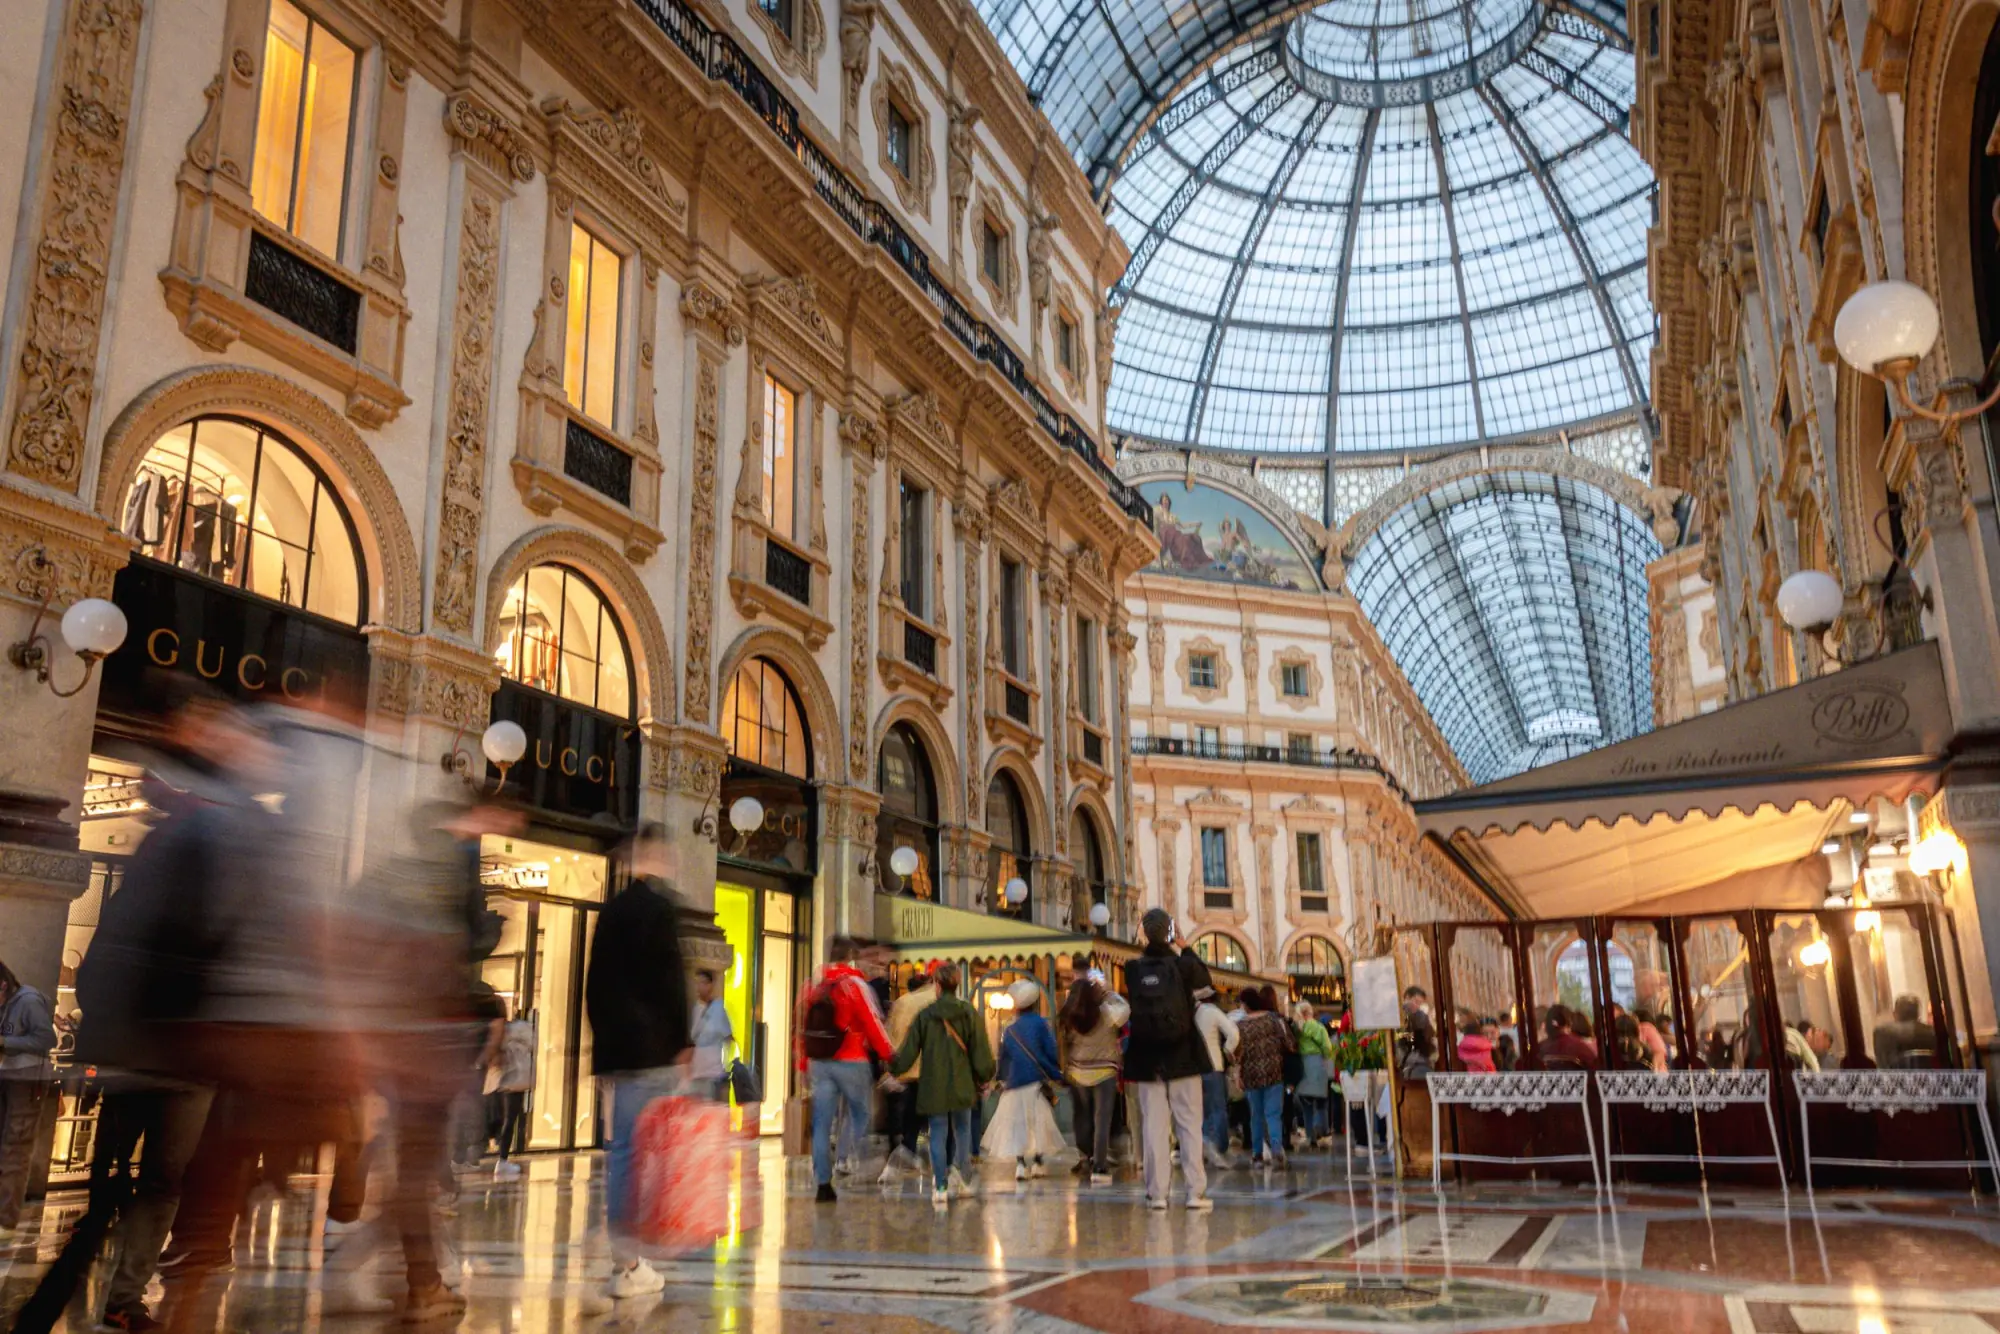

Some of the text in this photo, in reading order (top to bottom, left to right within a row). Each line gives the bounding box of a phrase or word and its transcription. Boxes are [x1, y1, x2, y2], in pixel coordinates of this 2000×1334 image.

[147, 628, 327, 708] GUCCI
[1823, 694, 1896, 738] Biffi
[535, 738, 615, 788] UCCI
[763, 807, 801, 840] CCI
